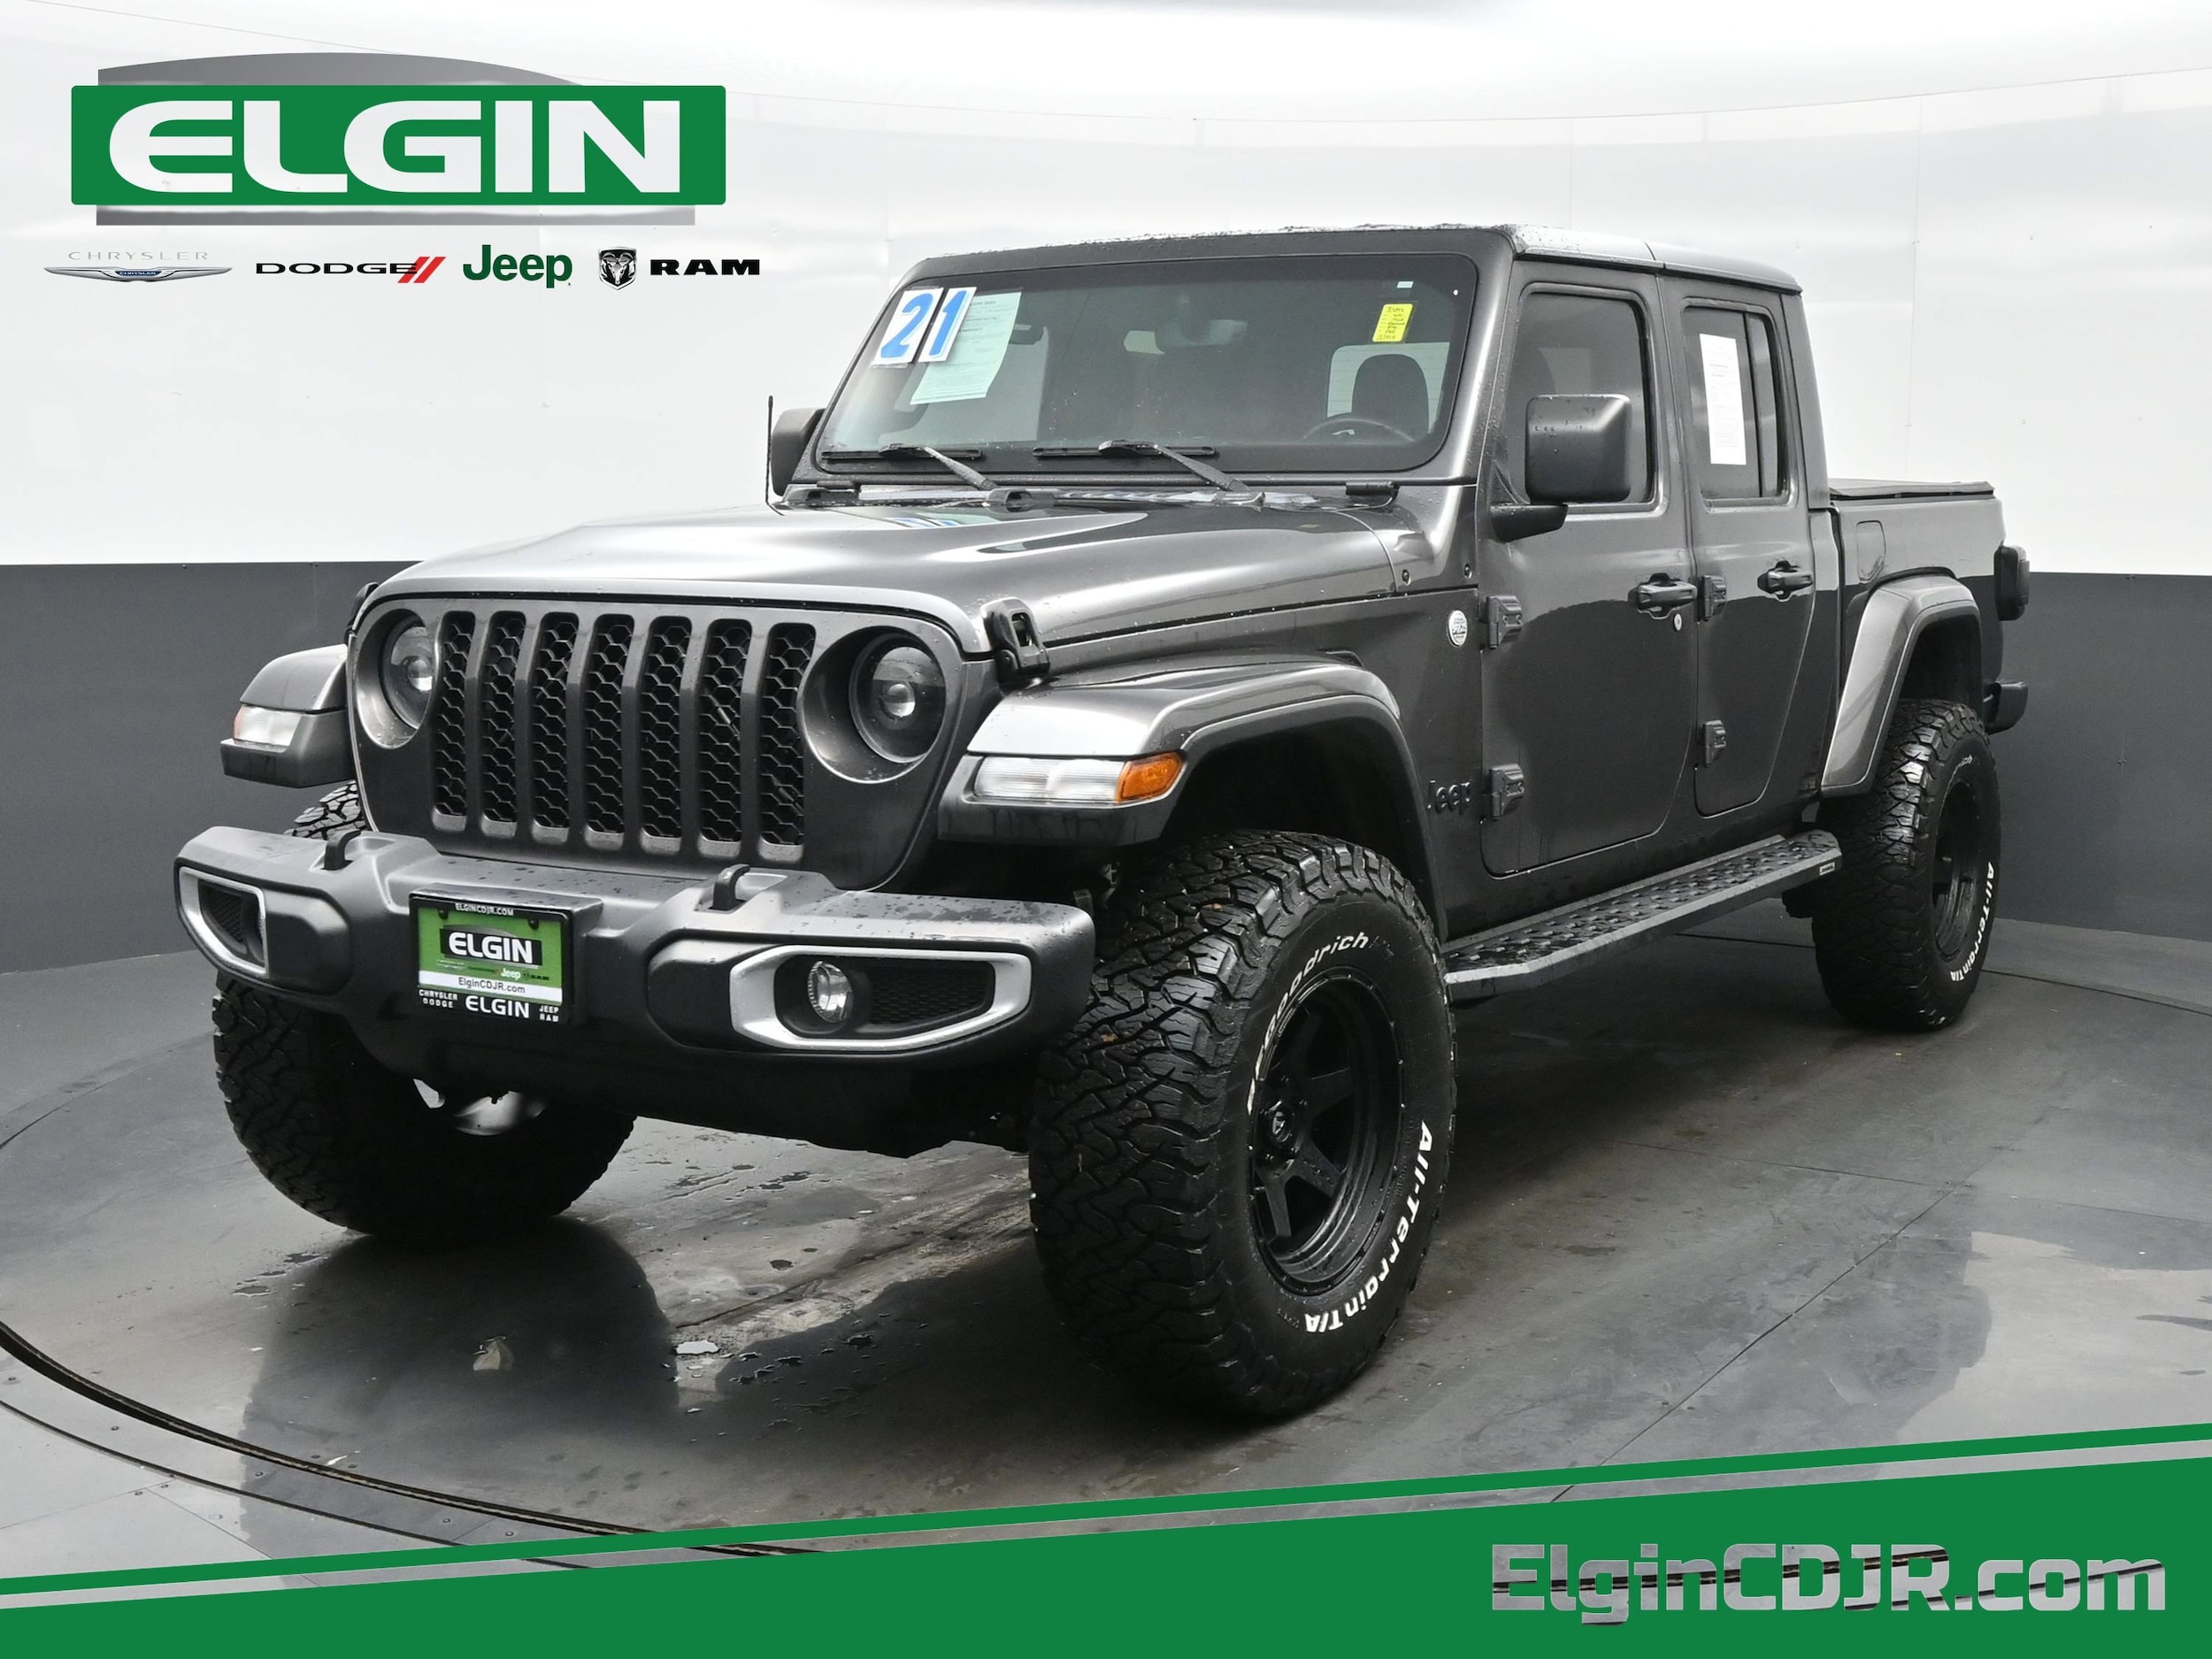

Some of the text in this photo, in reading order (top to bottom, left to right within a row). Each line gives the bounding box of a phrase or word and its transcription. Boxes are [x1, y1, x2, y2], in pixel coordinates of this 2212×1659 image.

[880, 289, 968, 358] 21
[455, 902, 515, 917] ELGINCDJR.COM
[1962, 861, 1995, 974] All-Terrain
[449, 932, 534, 964] ELGIN
[501, 967, 521, 981] Jeep
[458, 977, 526, 995] ElginCDJR.com
[419, 989, 458, 1002] CHRYSLER
[423, 997, 454, 1009] DODGE
[465, 995, 530, 1018] ELGIN
[539, 1004, 559, 1014] JEEP
[539, 1013, 559, 1023] RAM
[1304, 1120, 1435, 1333] All-Terrain T/A
